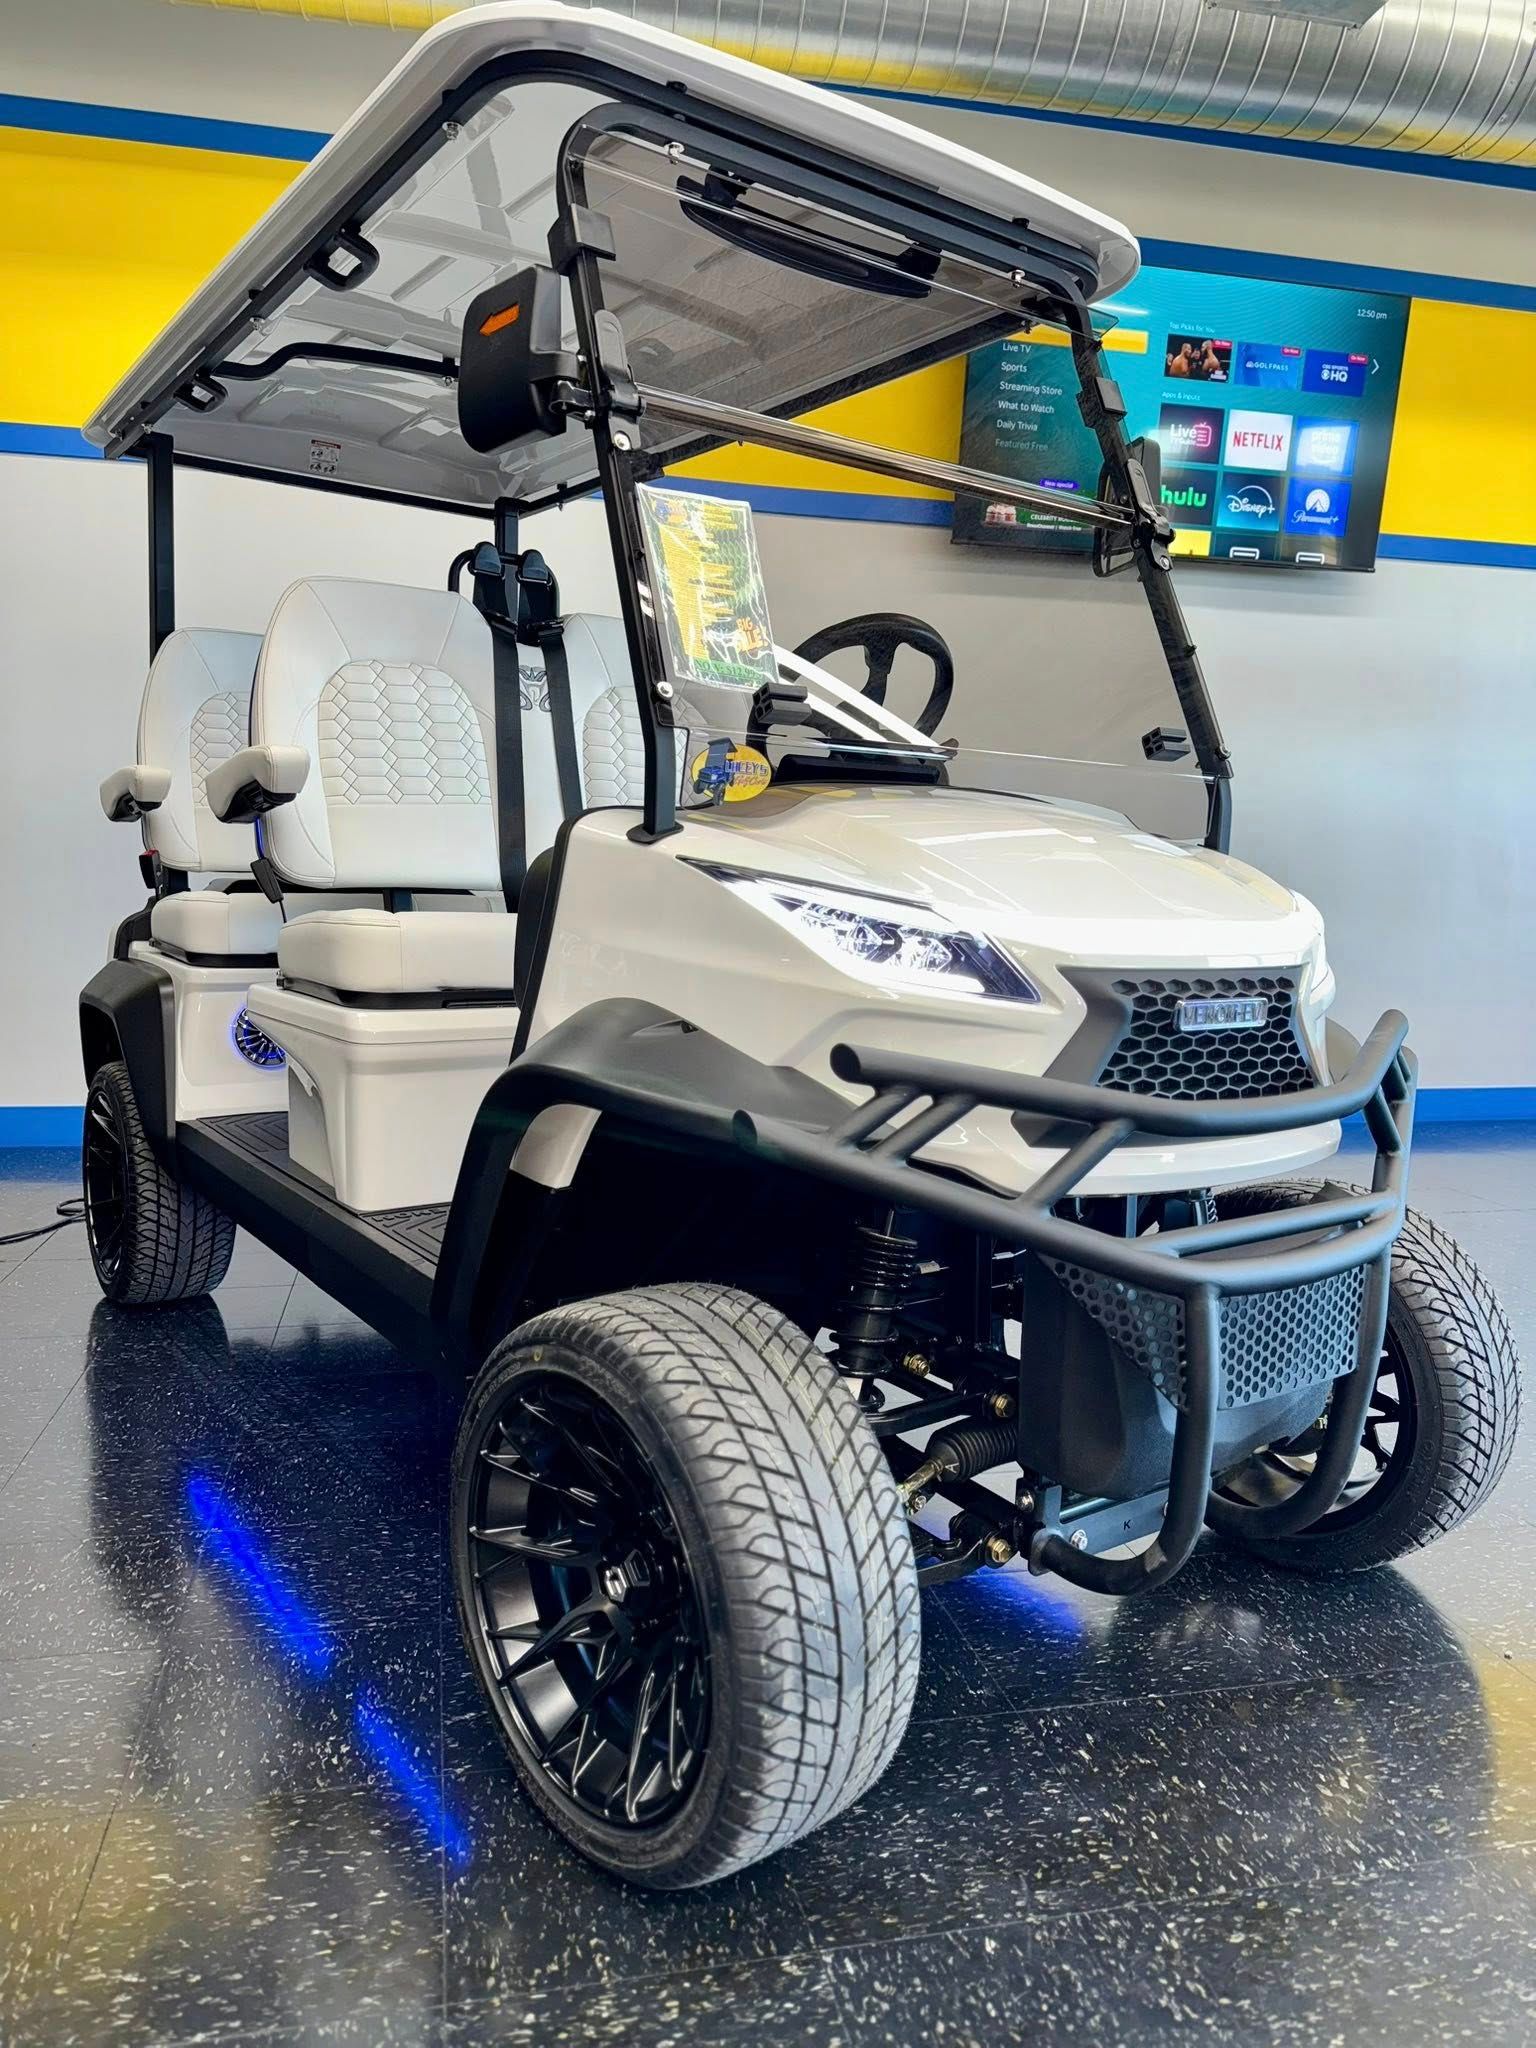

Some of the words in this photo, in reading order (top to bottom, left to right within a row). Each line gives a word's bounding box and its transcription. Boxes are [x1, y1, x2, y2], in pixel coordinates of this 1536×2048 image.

[1357, 308, 1376, 318] 12:50
[1376, 312, 1388, 320] pm
[1002, 342, 1019, 352] Live
[1020, 344, 1032, 353] TV
[1001, 361, 1028, 373] Sports
[1254, 361, 1289, 372] GOLFPASS
[1330, 370, 1348, 383] HQ
[999, 380, 1040, 395] Streaming
[1041, 385, 1063, 396] Store
[1161, 391, 1176, 400] Apps
[998, 400, 1019, 411] What
[1020, 402, 1030, 411] to
[1030, 404, 1055, 414] Watch
[996, 419, 1016, 431] Daily
[1017, 421, 1038, 431] Trivia
[1170, 423, 1198, 438] Live
[995, 438, 1030, 450] Featured
[1031, 441, 1049, 451] Free
[1232, 430, 1284, 452] NETFLIX
[1161, 484, 1207, 507] hulu
[1226, 492, 1276, 519] Disney+
[1292, 510, 1340, 525] Paramount+
[735, 616, 754, 632] BIG
[1123, 1519, 1132, 1531] K
